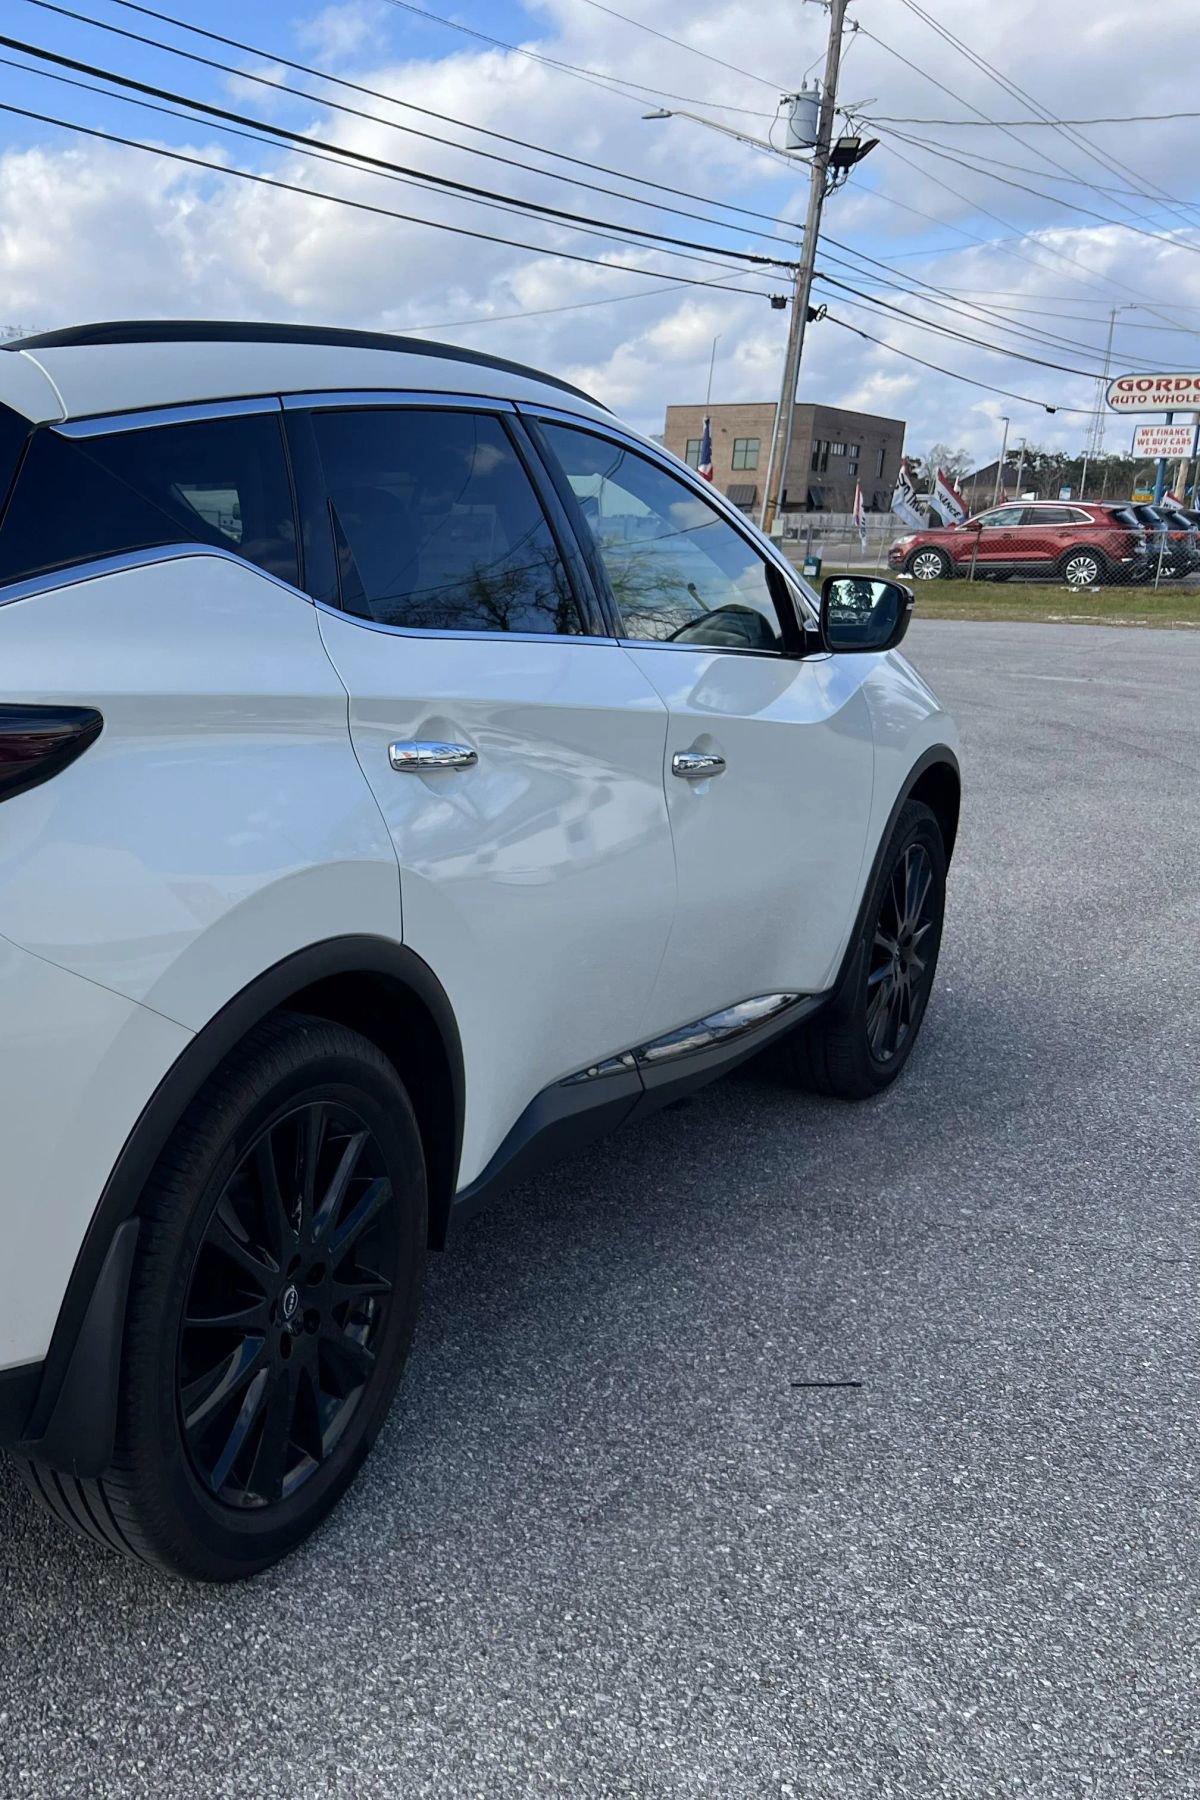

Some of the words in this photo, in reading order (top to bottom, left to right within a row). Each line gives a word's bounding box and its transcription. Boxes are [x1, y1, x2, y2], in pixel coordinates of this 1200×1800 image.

[1111, 395, 1147, 405] AUTO
[1156, 428, 1190, 436] FINANCE
[1152, 438, 1168, 446] BUY
[1170, 437, 1191, 445] CARS
[1144, 447, 1184, 455] 479-9200
